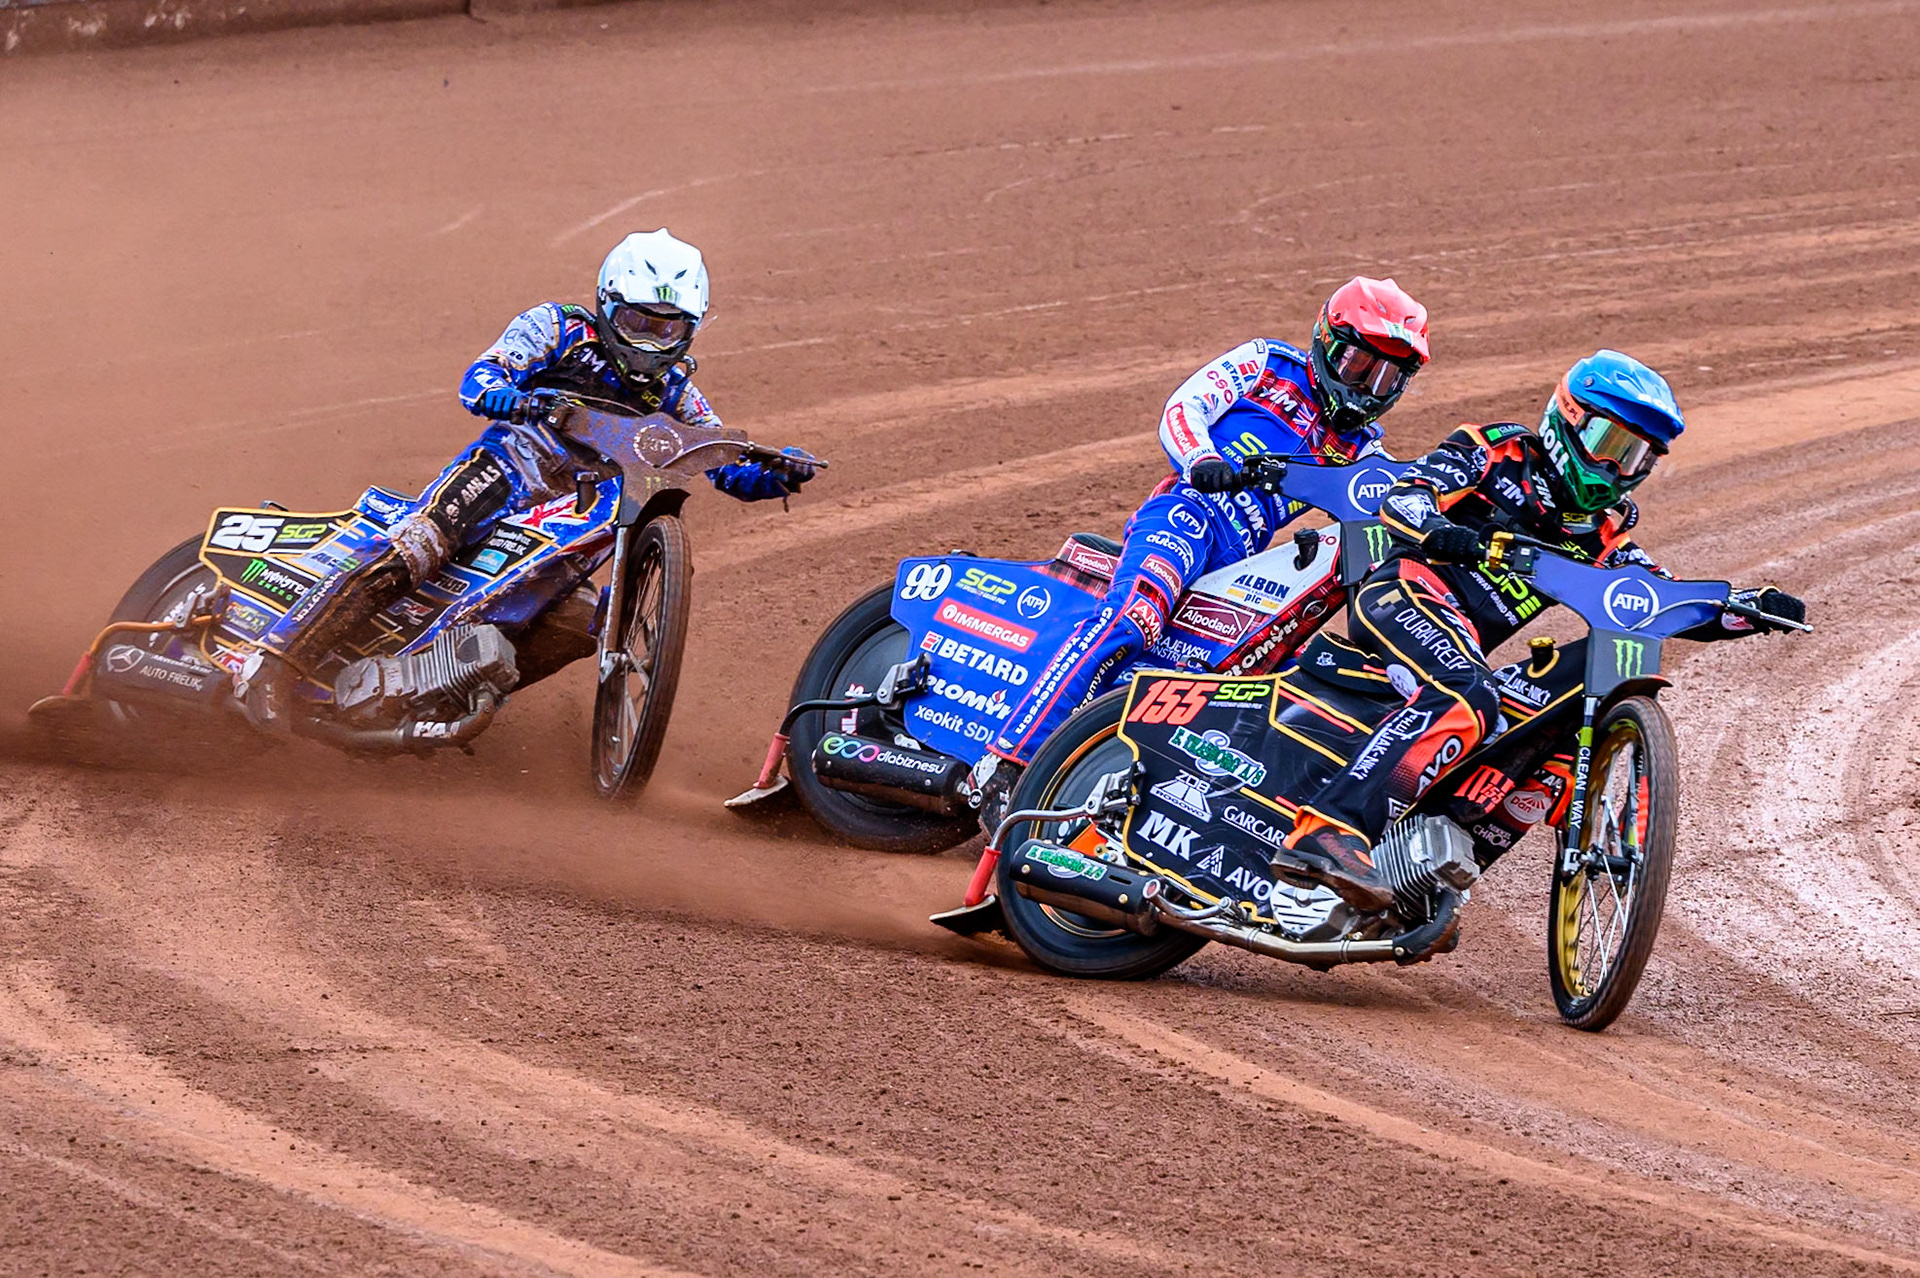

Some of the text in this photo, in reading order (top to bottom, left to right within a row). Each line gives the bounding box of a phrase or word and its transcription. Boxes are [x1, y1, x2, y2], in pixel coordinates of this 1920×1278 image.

[1221, 360, 1244, 399] BETARD
[1430, 463, 1468, 487] AVO
[210, 514, 328, 553] 25 SGP
[1174, 510, 1202, 533] ATPI
[900, 563, 1018, 601] 99 SGP
[1146, 560, 1180, 598] Alpodach
[1233, 574, 1291, 599] ALBON
[1022, 594, 1046, 611] ATPI
[1243, 592, 1262, 606] plc
[1612, 592, 1650, 614] ATPI
[953, 611, 1029, 648] IMMERGAS
[1182, 609, 1238, 636] Alpodach
[937, 637, 1029, 686] BETARD
[1156, 632, 1212, 662] RAJEWSKI
[139, 665, 204, 691] AUTO FRELIK
[1014, 606, 1114, 735] Grant Henderson
[1126, 679, 1271, 726] 155 SGP
[914, 704, 964, 733] xeokit
[876, 750, 948, 775] dlabiznesu
[1415, 738, 1462, 798] AVO
[1175, 769, 1211, 794] ZDB
[1569, 746, 1591, 830] CLEAN WAY
[1155, 789, 1206, 818] ROGOWO
[1510, 795, 1533, 814] Dan
[1136, 810, 1202, 862] MK
[1223, 805, 1287, 847] GARCAR
[1224, 865, 1274, 901] AVO
